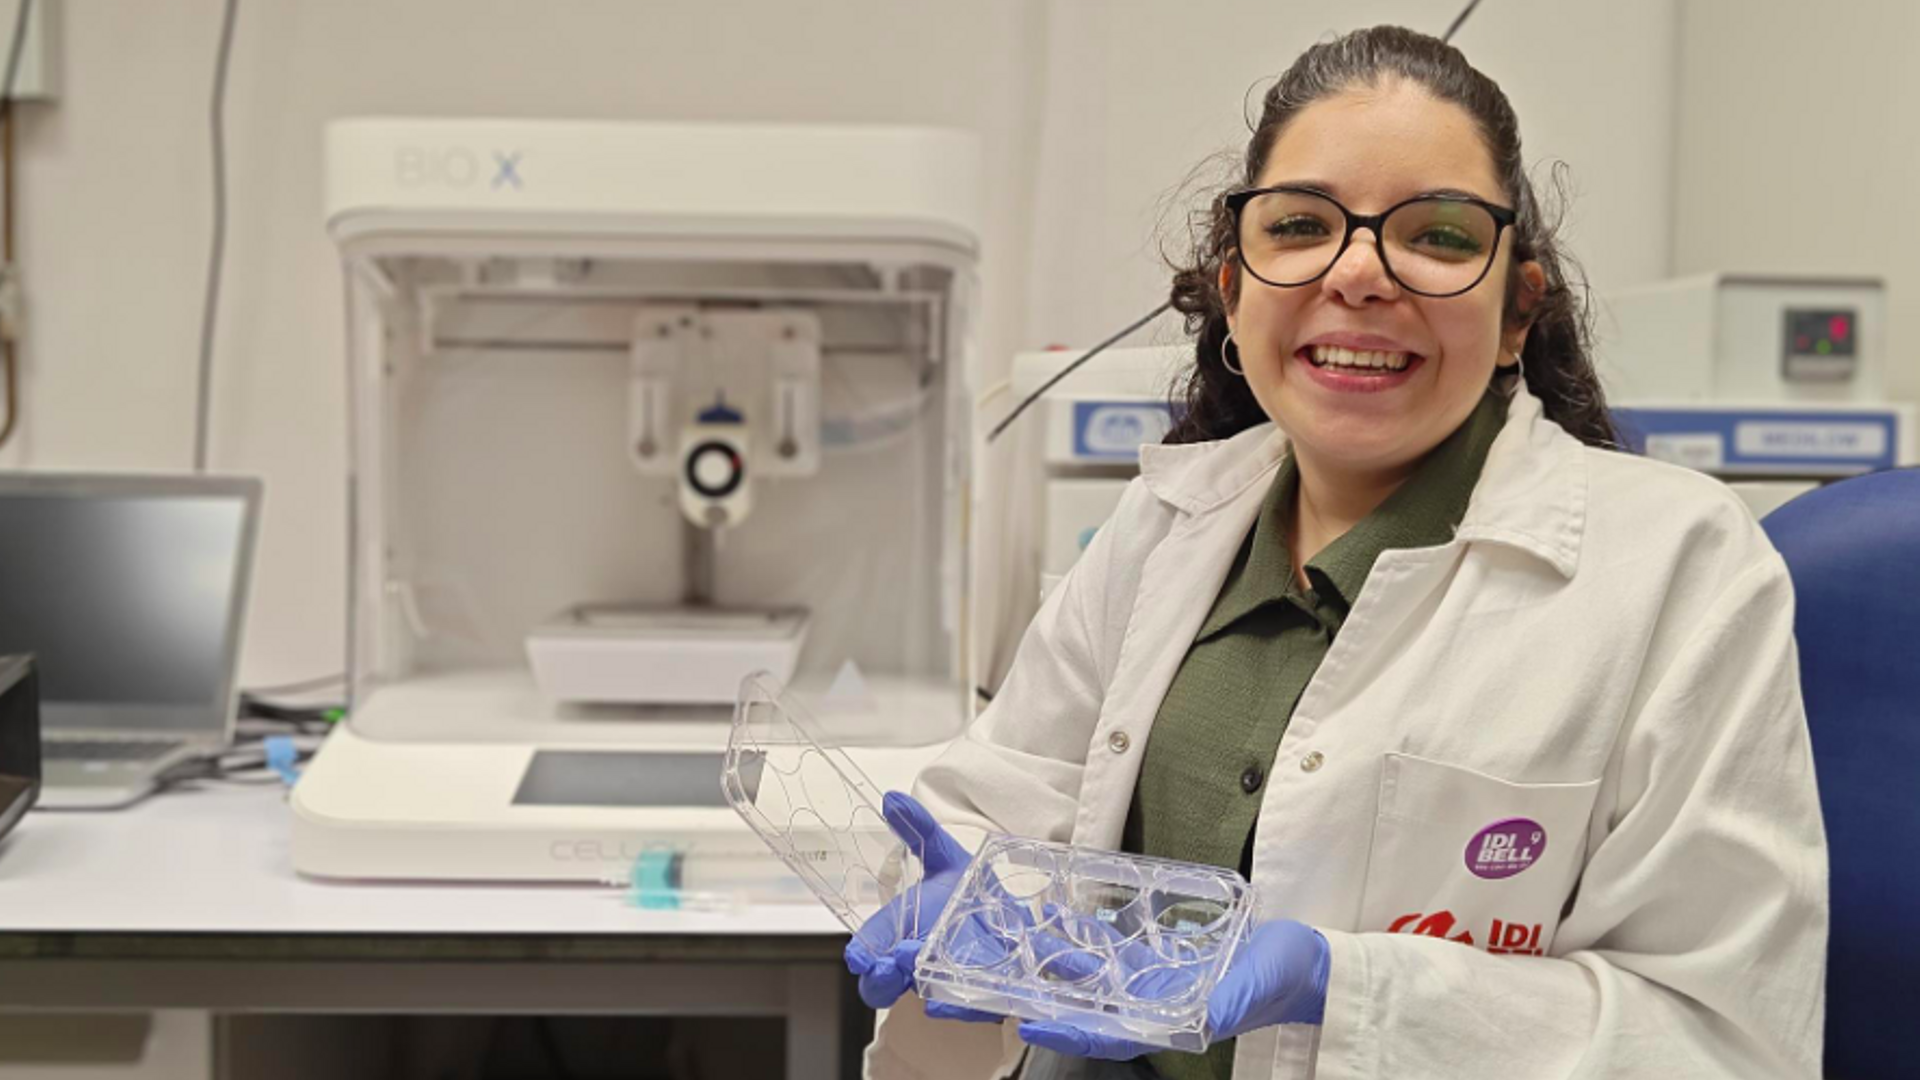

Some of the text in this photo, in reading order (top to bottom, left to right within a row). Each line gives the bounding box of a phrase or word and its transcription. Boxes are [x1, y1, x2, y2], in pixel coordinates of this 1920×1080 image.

[393, 146, 525, 192] BIO X
[551, 840, 696, 861] CELL
[1482, 832, 1517, 849] IDI
[1477, 848, 1532, 862] BELL
[1488, 918, 1542, 947] IDI
